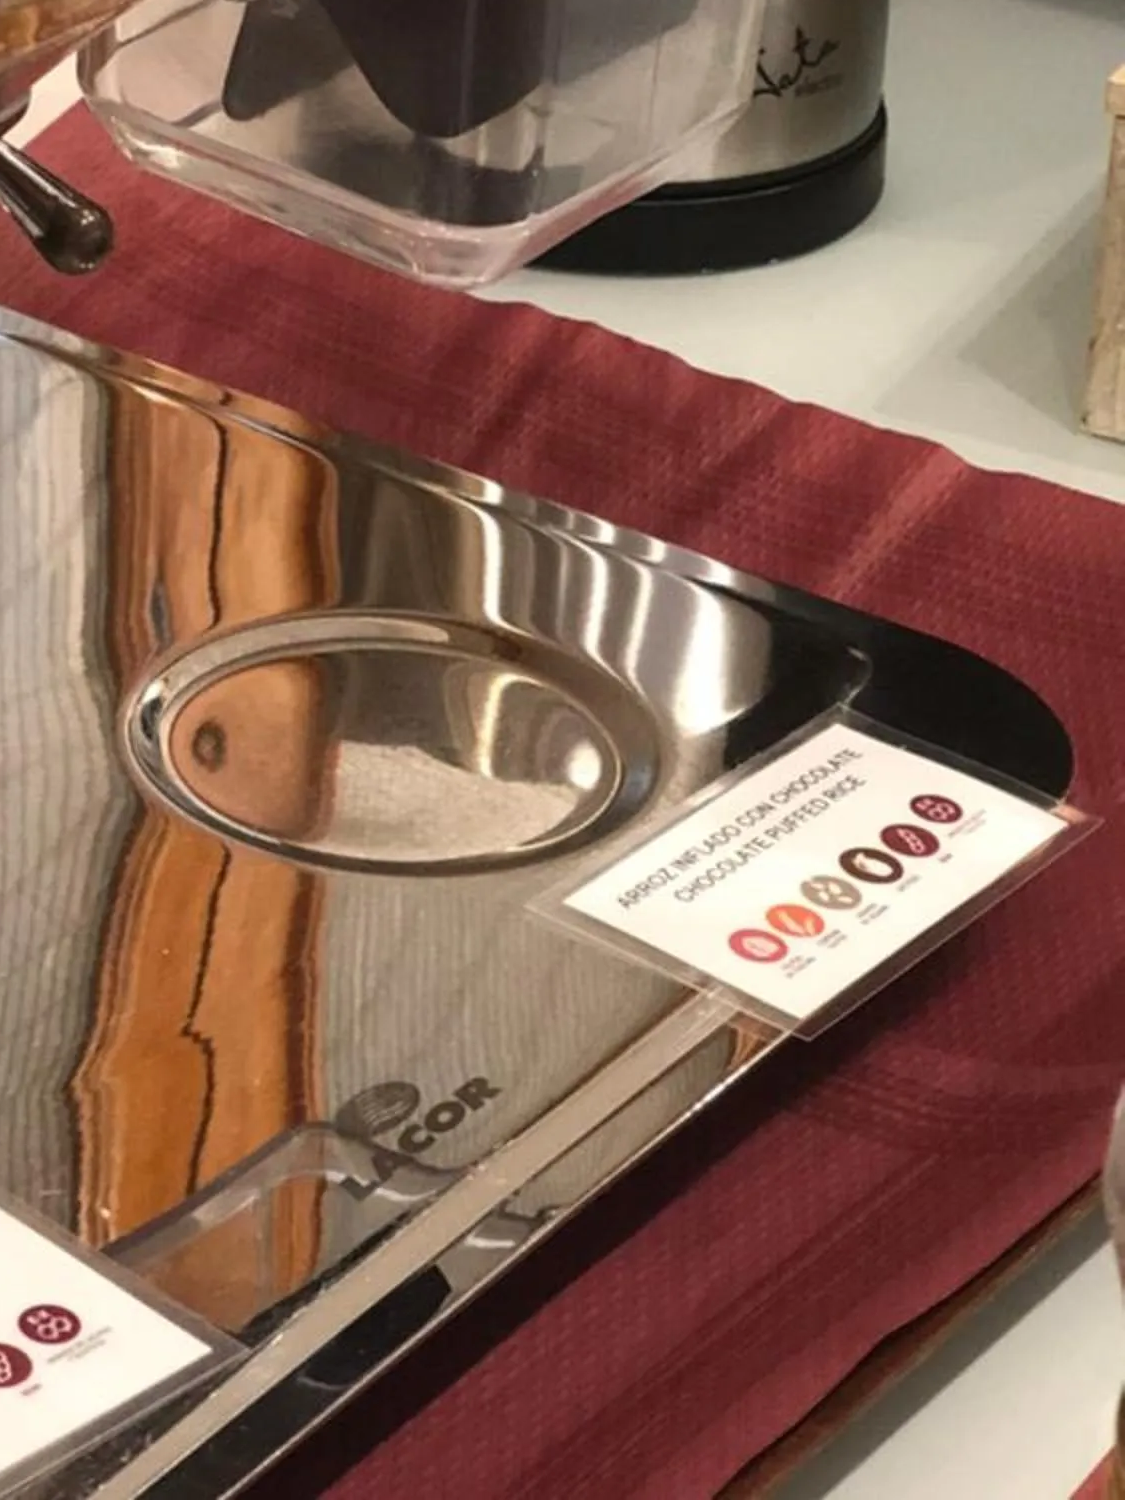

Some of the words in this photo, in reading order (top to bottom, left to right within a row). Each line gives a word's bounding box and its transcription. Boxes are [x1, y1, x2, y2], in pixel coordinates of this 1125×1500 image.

[618, 867, 679, 909] ARROZ
[670, 824, 742, 873] INFLADO
[735, 802, 776, 829] CON
[770, 748, 864, 804] CHOCOLATE
[673, 835, 776, 903] CHOCOLATE
[764, 800, 831, 841] PUFFED
[824, 774, 867, 801] RICE
[338, 1076, 503, 1201] LACOR
